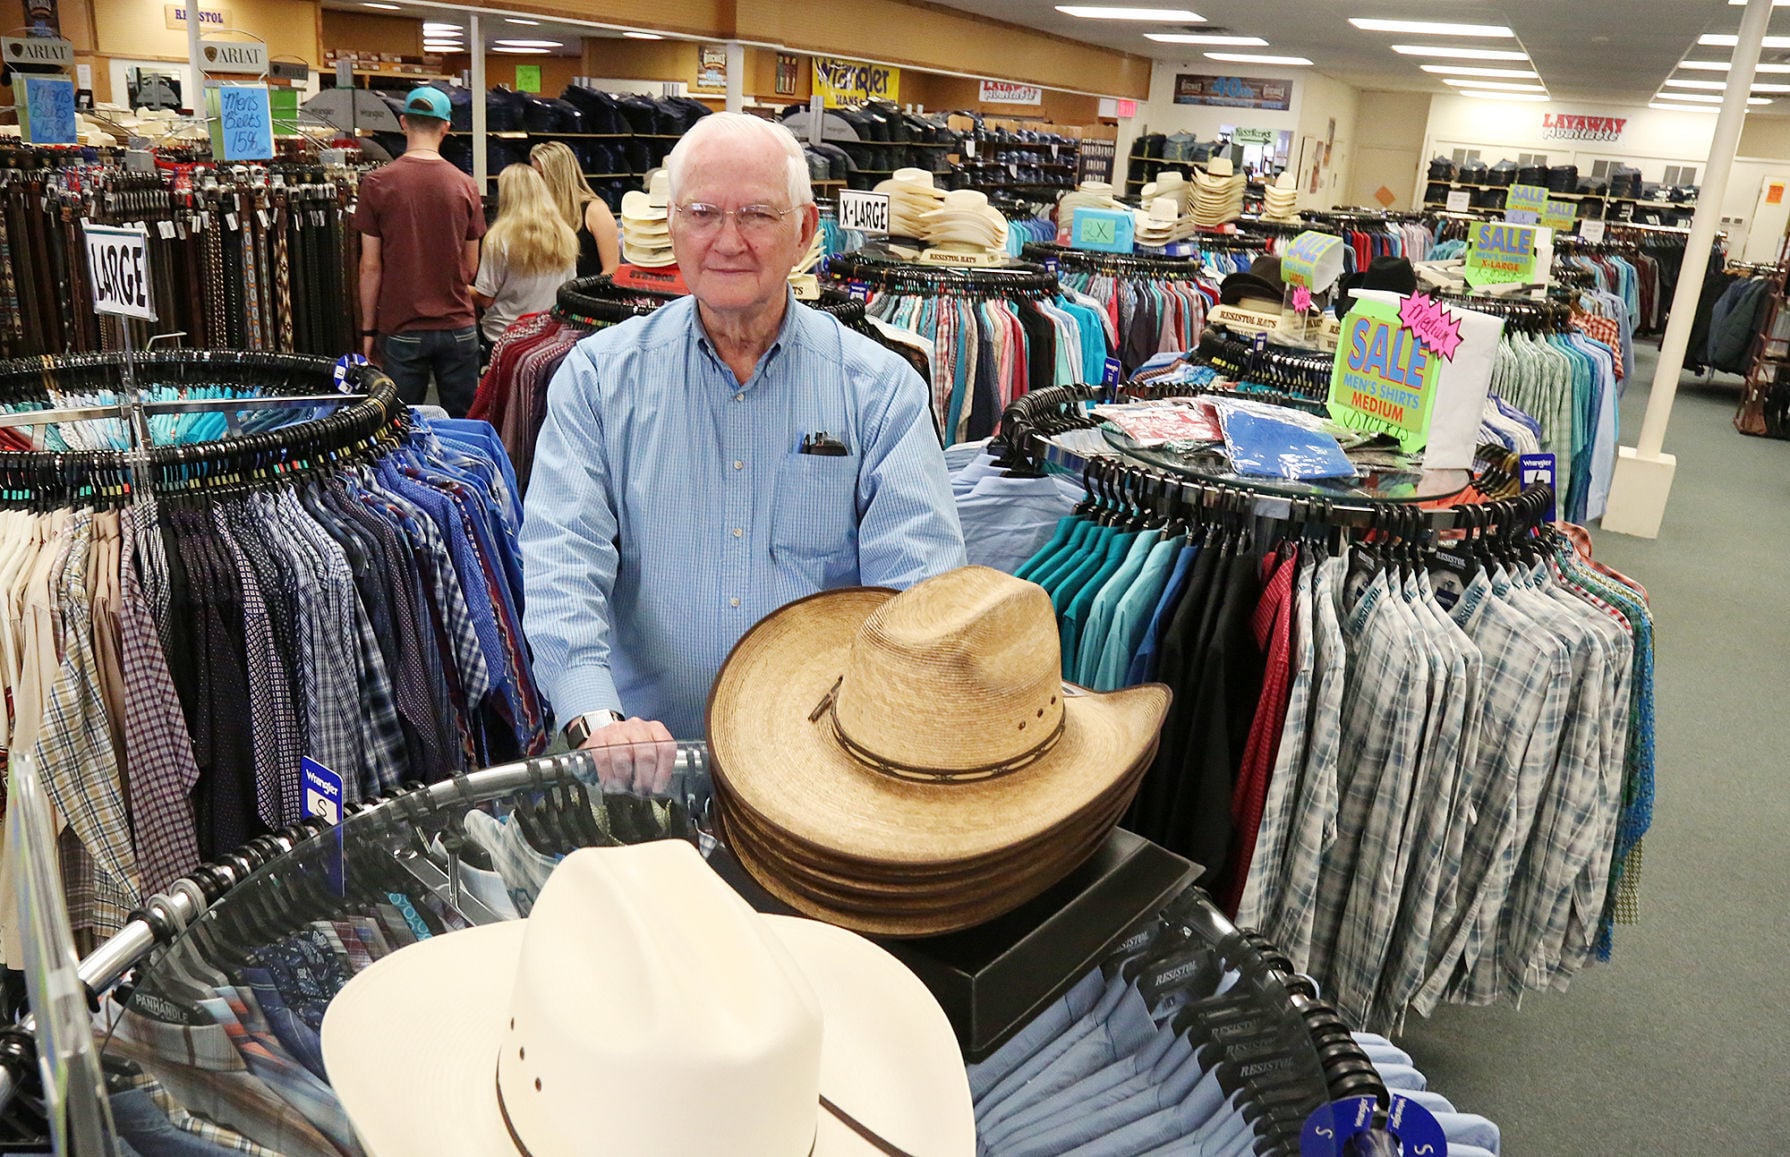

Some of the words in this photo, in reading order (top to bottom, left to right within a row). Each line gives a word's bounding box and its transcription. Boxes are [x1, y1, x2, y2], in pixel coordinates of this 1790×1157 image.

[175, 9, 223, 23] RSTOL
[26, 44, 67, 60] ARIAT
[219, 47, 261, 64] ARIAT
[815, 57, 889, 98] Wrangler
[1542, 113, 1627, 134] LAYAWAY
[231, 130, 258, 153] 15%
[1511, 185, 1545, 203] SALE
[842, 199, 887, 230] X-LARGE
[1546, 201, 1574, 217] SALE
[1287, 230, 1337, 264] SALE
[1478, 225, 1531, 254] SALE
[91, 243, 146, 308] LARGE
[1482, 259, 1519, 272] X-LARGE
[1219, 310, 1256, 325] RESISTOL
[1256, 315, 1277, 330] HATS
[1407, 303, 1450, 348] Medium
[1347, 316, 1430, 390] SALE
[1343, 373, 1377, 395] MEN'S
[1380, 384, 1420, 409] SHIRTS
[1351, 391, 1404, 423] MEDIUM
[1523, 459, 1552, 468] Wrangler
[1436, 551, 1466, 567] RESISTOL
[305, 768, 338, 796] Wrangler
[316, 799, 328, 817] S
[1155, 960, 1197, 986] RESISTOL
[135, 994, 188, 1021] PANHANDLE
[1240, 1057, 1296, 1077] RESISTOL
